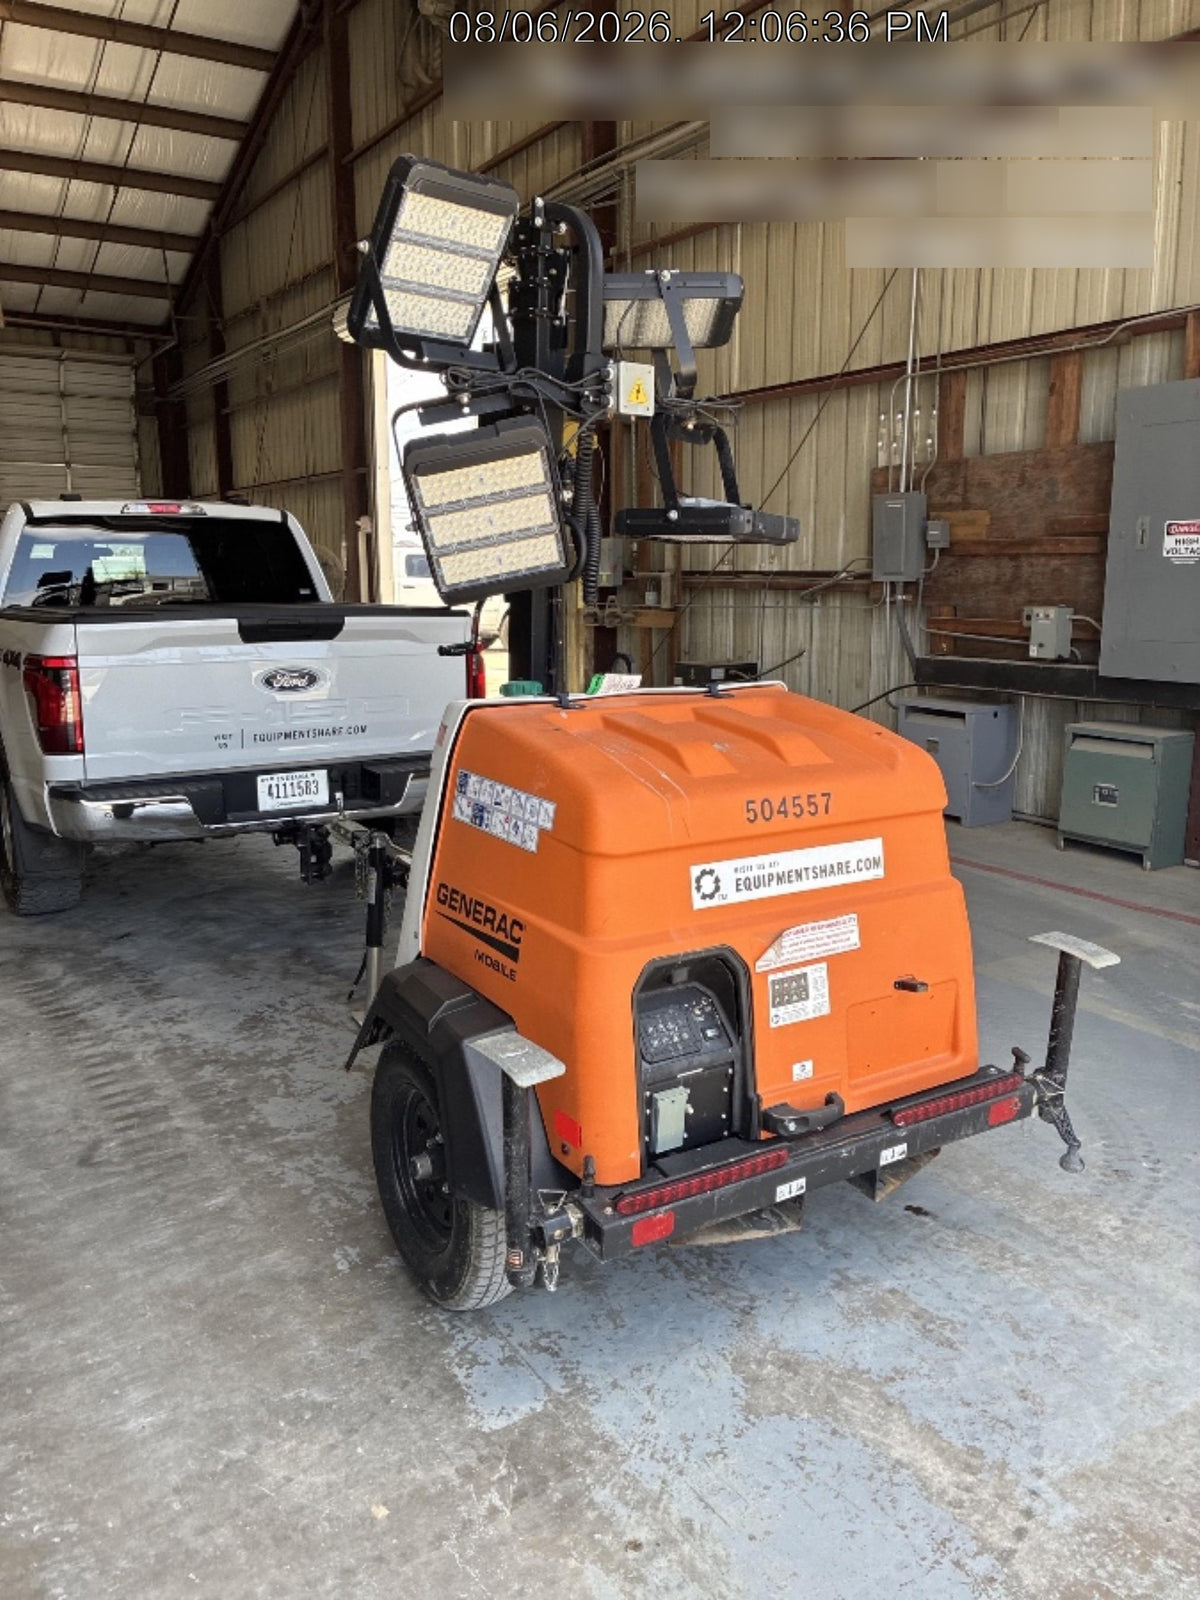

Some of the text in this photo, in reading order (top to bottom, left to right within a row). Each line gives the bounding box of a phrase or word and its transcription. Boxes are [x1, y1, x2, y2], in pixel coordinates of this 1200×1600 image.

[1175, 537, 1199, 546] HIGH
[272, 672, 309, 687] Ford
[253, 725, 367, 743] EQUIPMENTSHARE.COM
[746, 792, 832, 823] 504557
[735, 856, 881, 893] EQUIPMENTSHARE.COM
[437, 883, 524, 944] GENERAC
[475, 949, 517, 982] MOBILE
